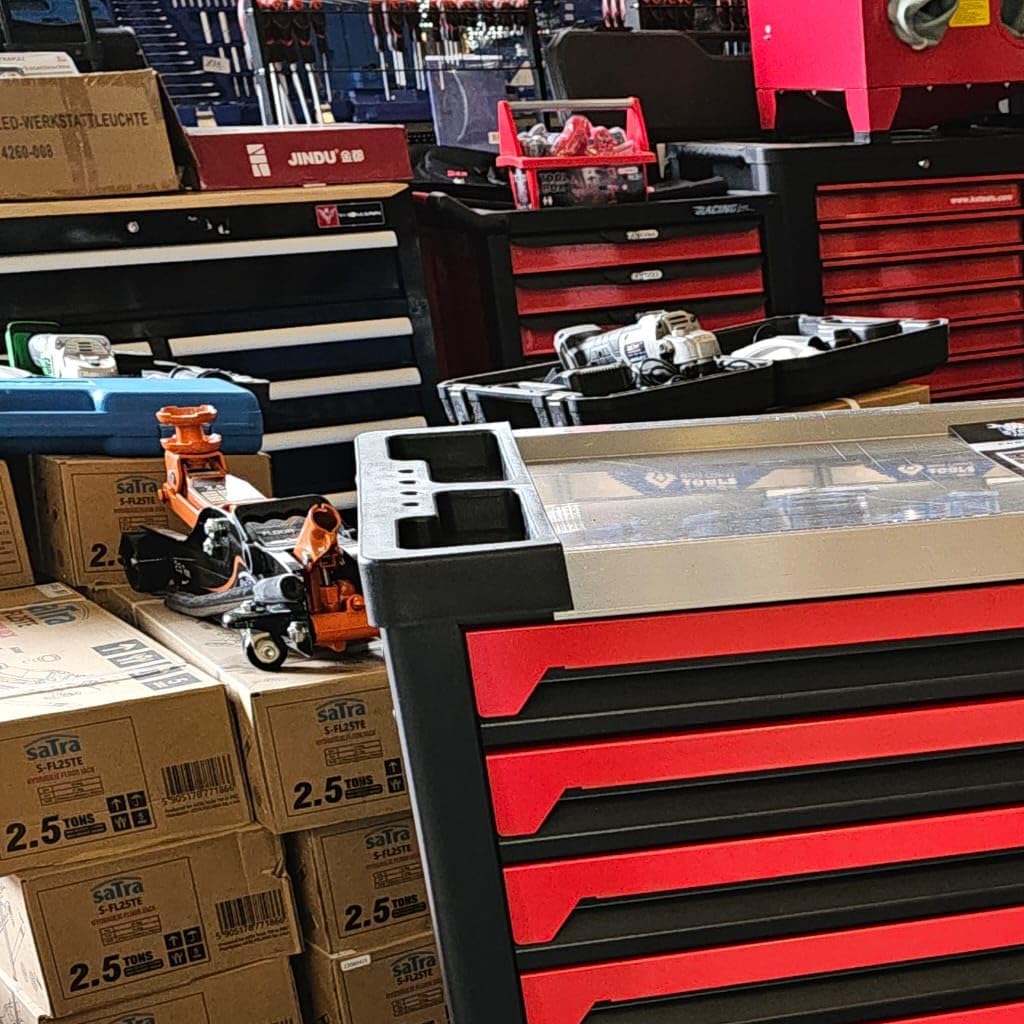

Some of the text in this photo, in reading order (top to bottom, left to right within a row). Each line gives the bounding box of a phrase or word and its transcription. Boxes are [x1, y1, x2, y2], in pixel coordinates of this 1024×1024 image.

[0, 112, 149, 130] ED-WERKSTATTLEUCHTE
[288, 151, 337, 166] JINDU
[36, 756, 84, 773] S-FL25TE
[293, 775, 374, 810] 2.5 TONS
[6, 813, 96, 852] 2.5 TONS
[98, 897, 144, 915] S-FL25TE
[344, 897, 390, 932] 2.5
[69, 951, 154, 992] 2.5 TONS
